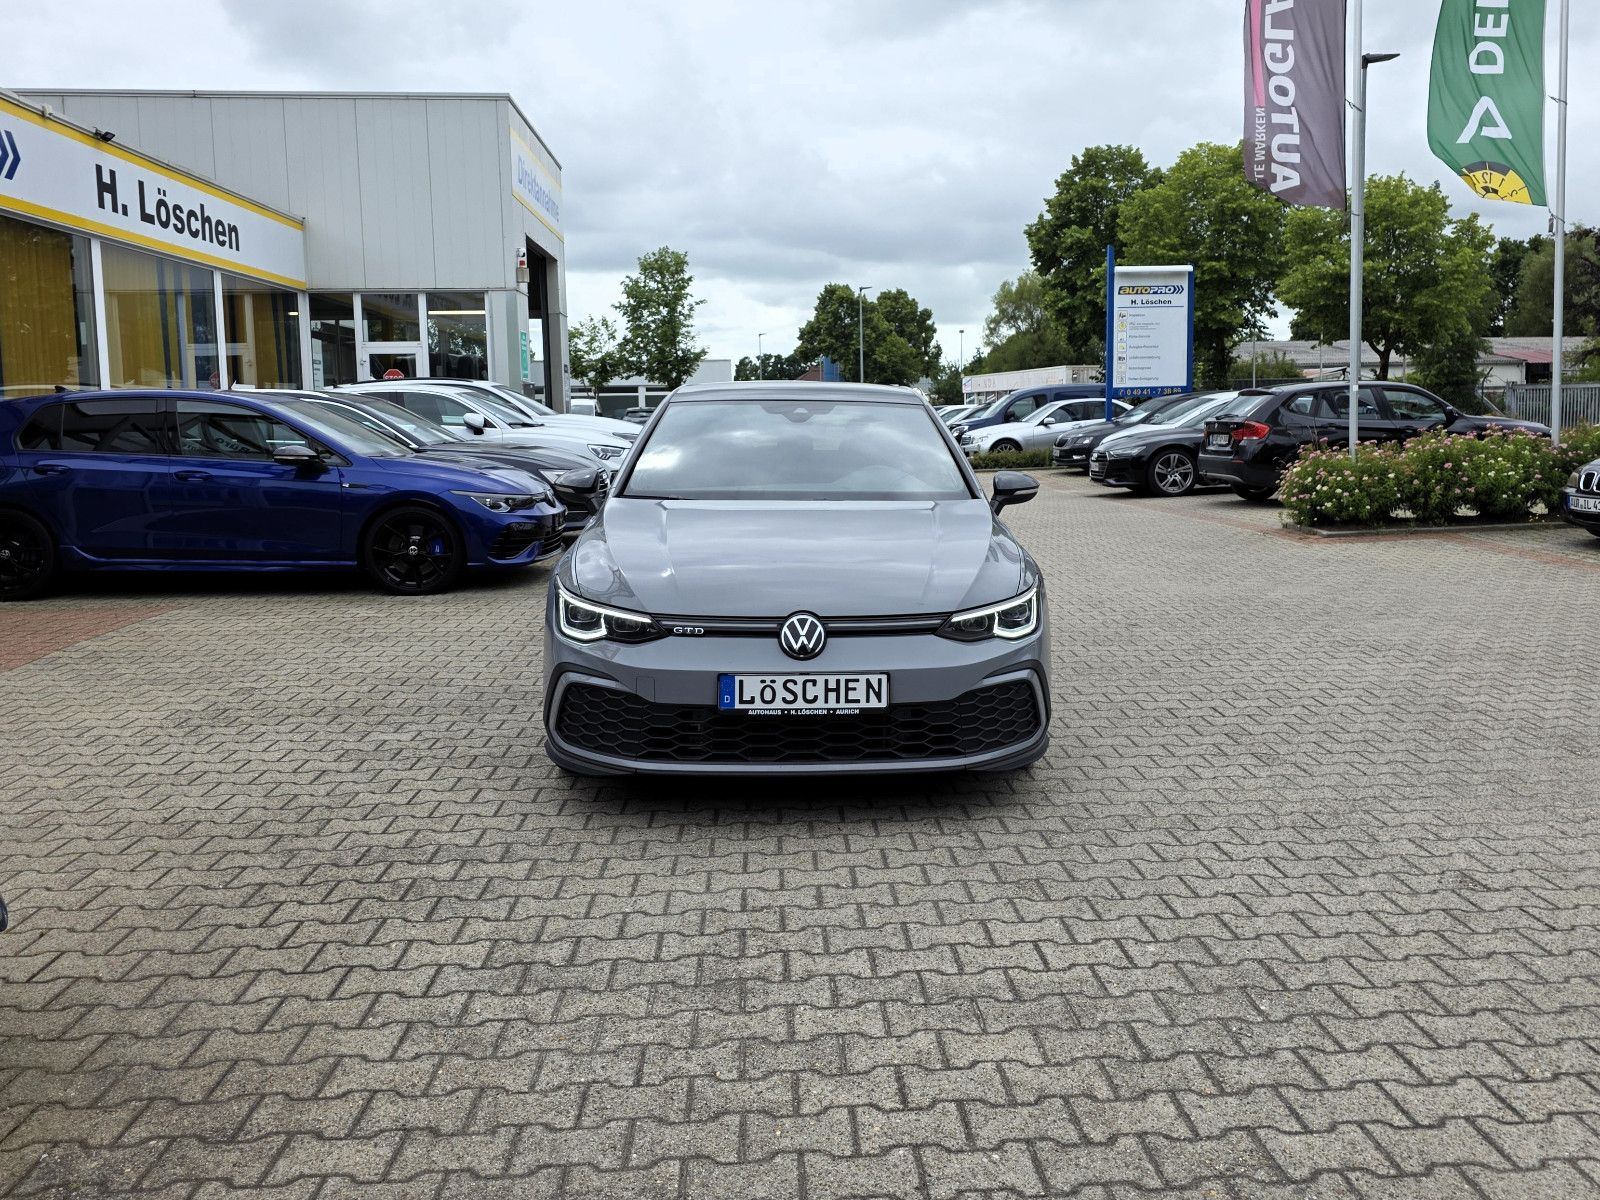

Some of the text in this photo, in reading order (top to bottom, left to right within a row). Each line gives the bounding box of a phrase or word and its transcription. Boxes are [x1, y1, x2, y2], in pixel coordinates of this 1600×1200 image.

[95, 163, 240, 252] H. Löschen
[673, 626, 704, 634] GTD
[724, 695, 730, 703] D
